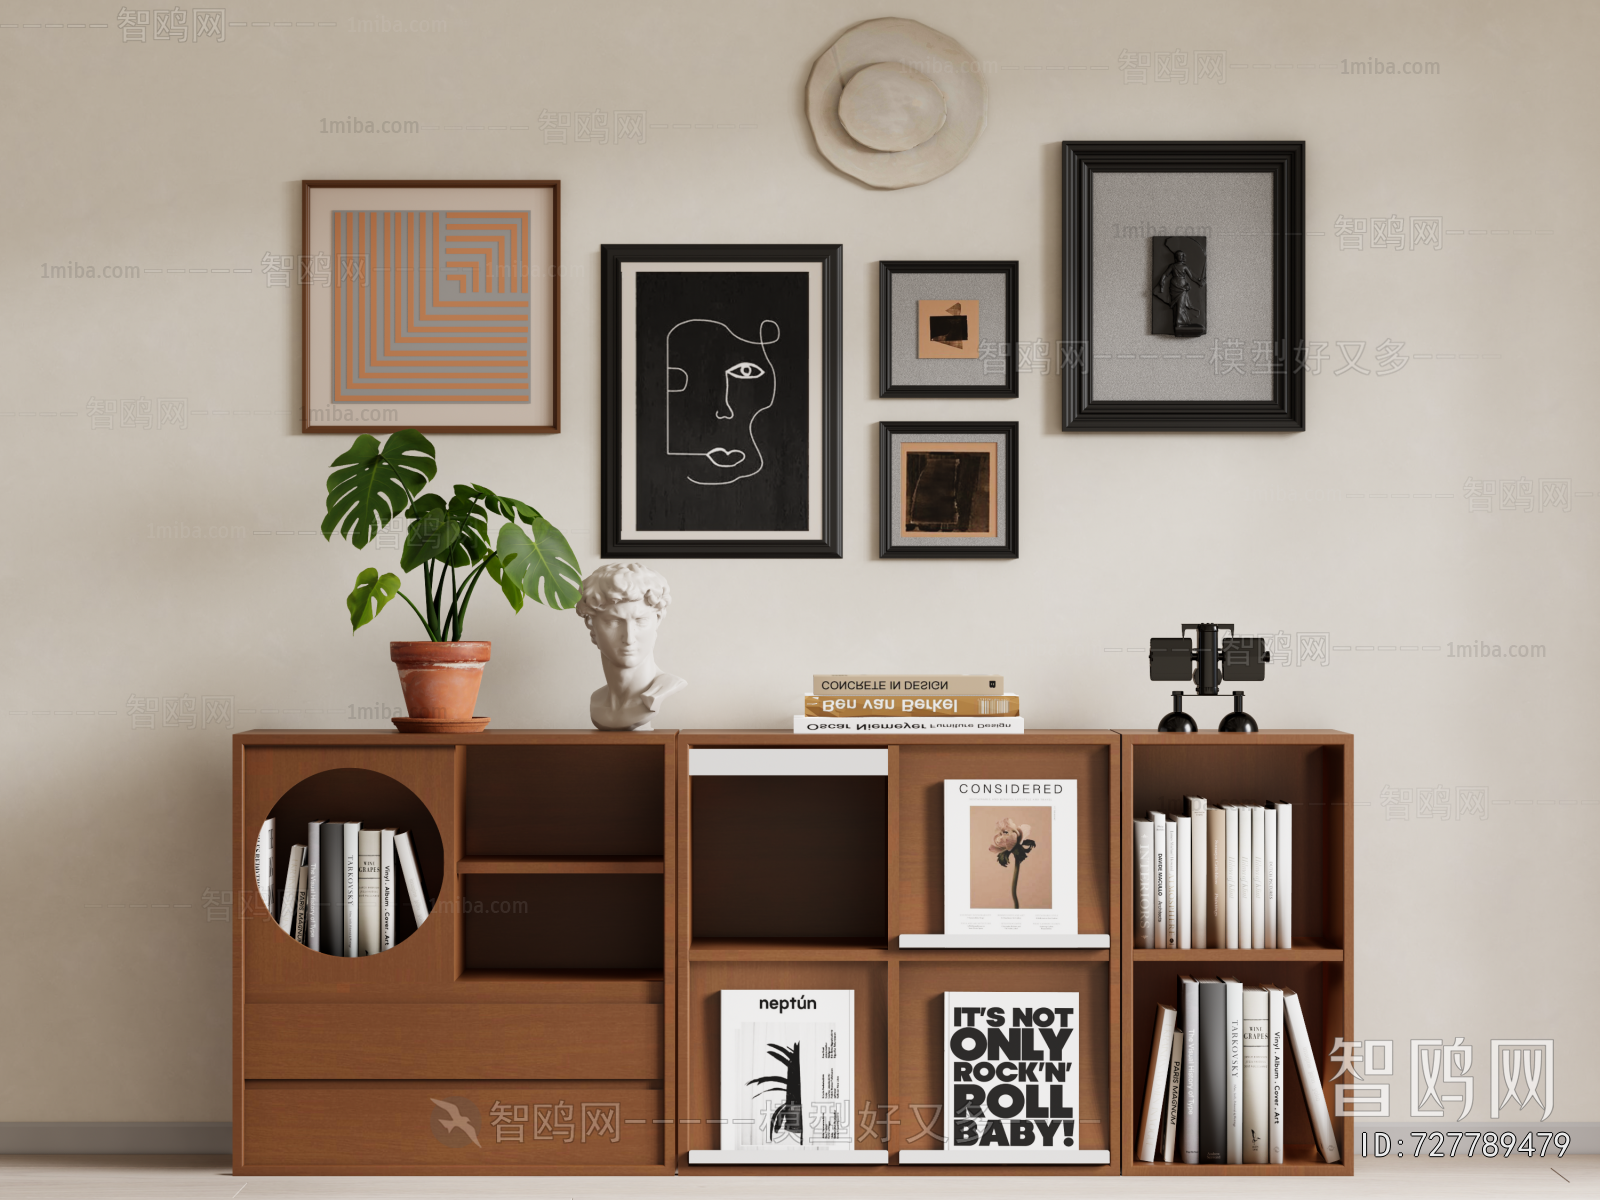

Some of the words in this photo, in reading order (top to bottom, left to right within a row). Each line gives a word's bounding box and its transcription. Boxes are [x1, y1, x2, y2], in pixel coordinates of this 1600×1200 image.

[959, 783, 1063, 794] CONSIDERED
[1140, 845, 1150, 928] INTERIORS
[759, 994, 817, 1014] neptún
[954, 1007, 1006, 1027] IT'S
[1012, 1007, 1074, 1027] NOT
[950, 1027, 1074, 1061] ONLY
[1243, 1032, 1268, 1040] GRAPES
[1273, 1031, 1281, 1050] Vinyl
[1231, 1020, 1239, 1078] TARKOVSKY
[1273, 1055, 1281, 1080] Album
[954, 1083, 1074, 1118] ROLL
[1170, 1086, 1178, 1126] MAGNUM
[1273, 1085, 1281, 1107] Cover
[954, 1119, 1075, 1147] BABY!
